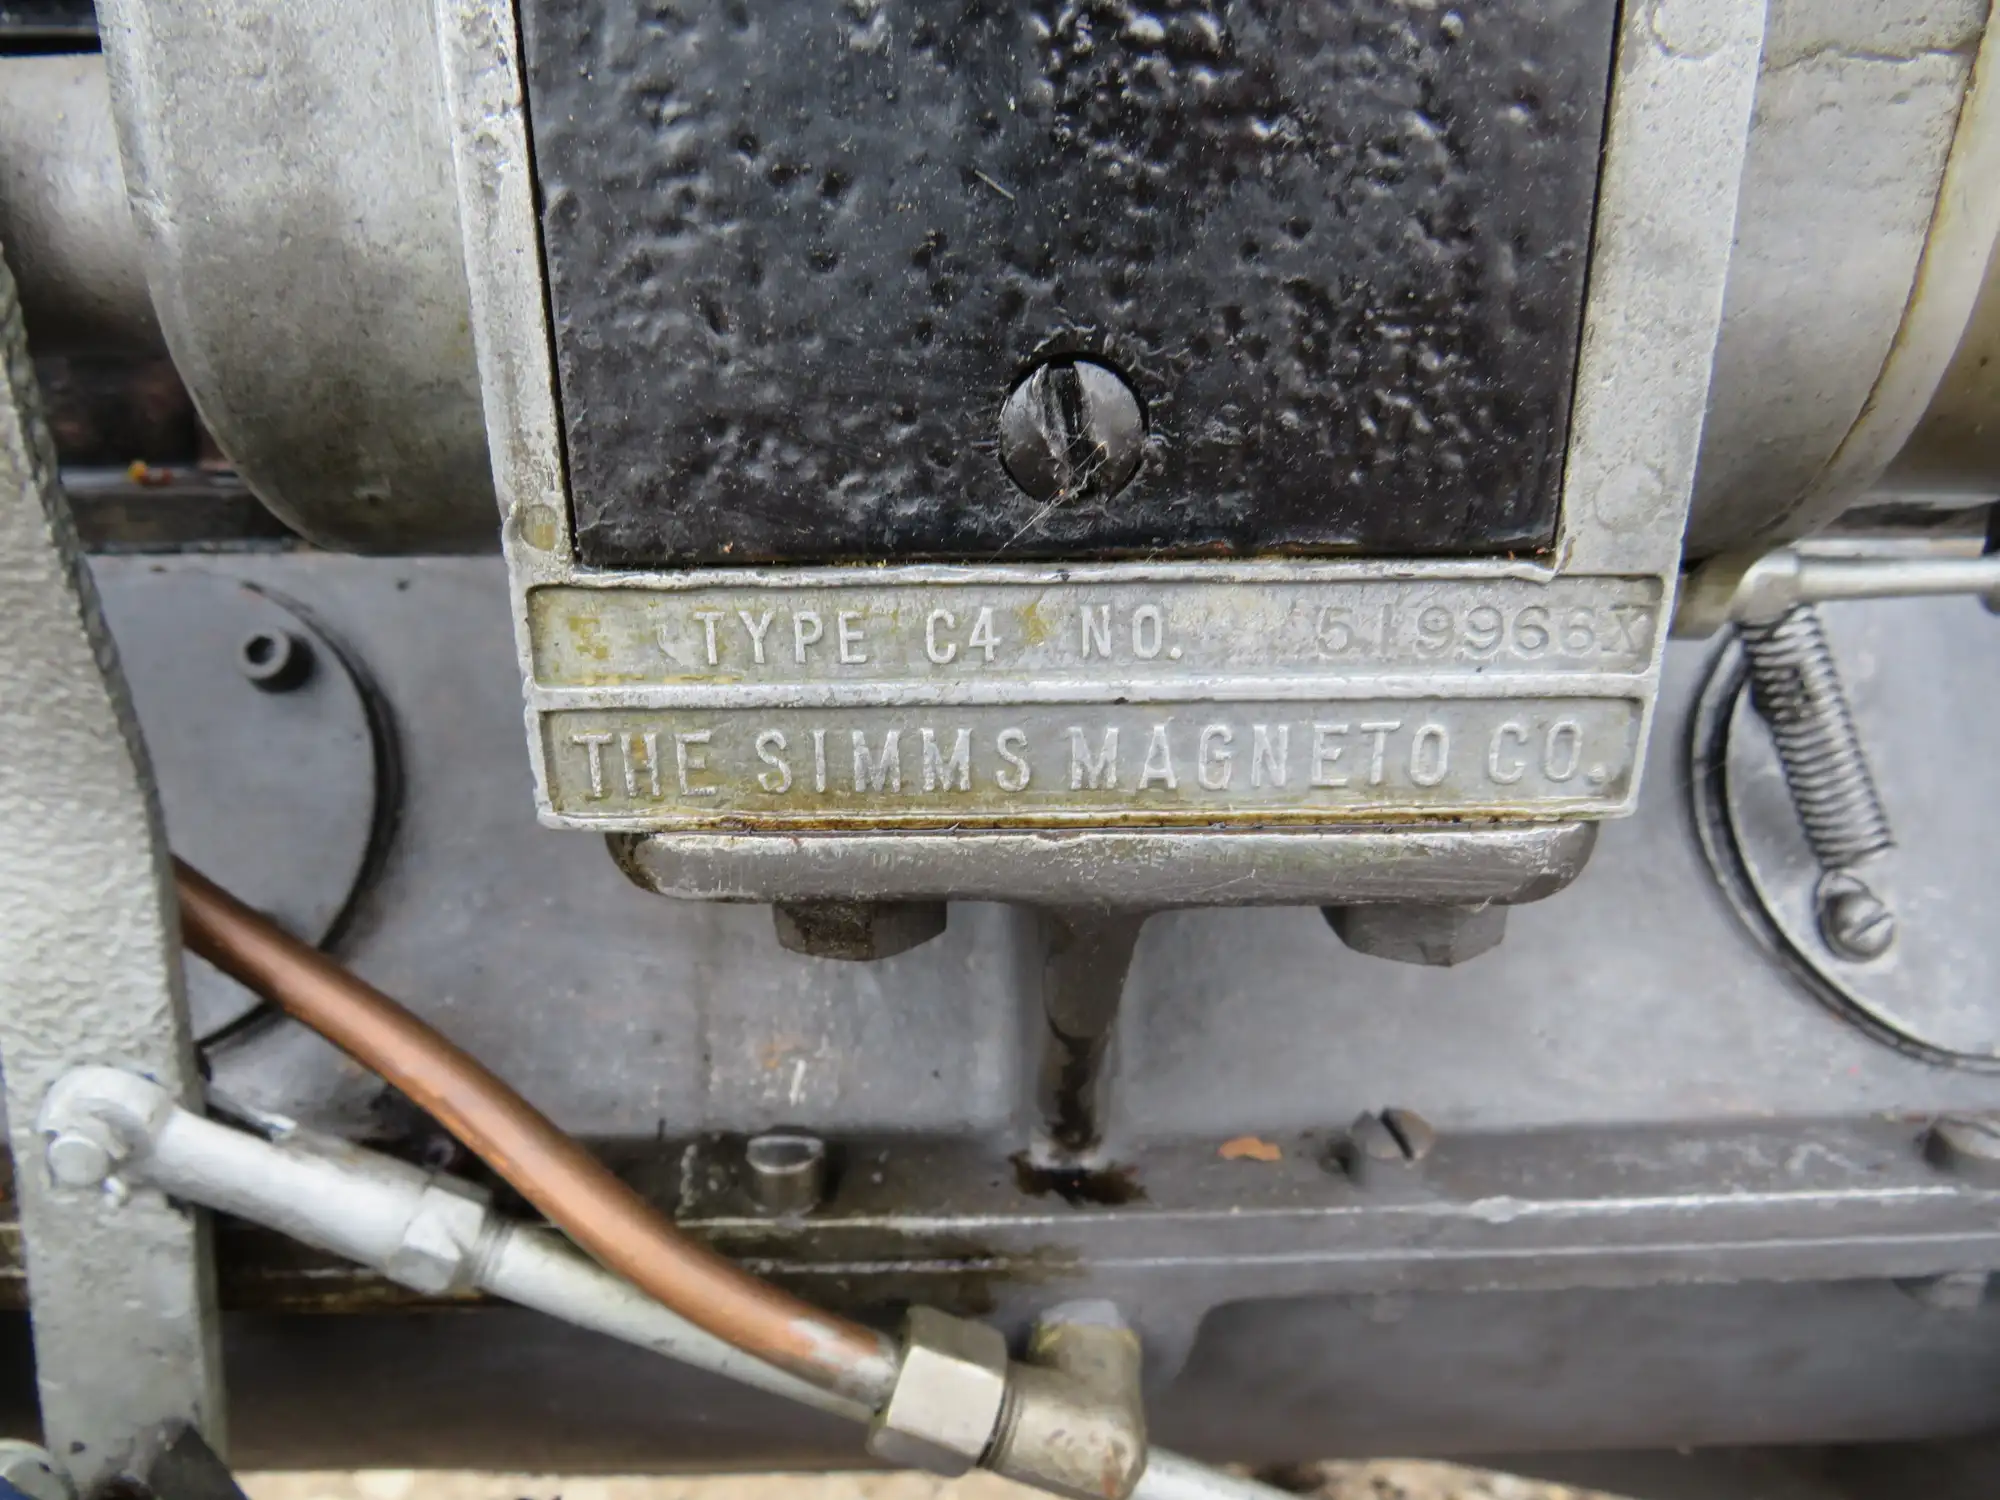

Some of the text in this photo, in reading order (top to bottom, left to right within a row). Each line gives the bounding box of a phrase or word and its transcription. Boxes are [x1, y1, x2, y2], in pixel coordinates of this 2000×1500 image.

[693, 608, 869, 666] TYPE
[924, 606, 1000, 665] C4
[1080, 603, 1183, 660] NO.
[571, 718, 1607, 798] THE SIMMS MAGNETO CO.
